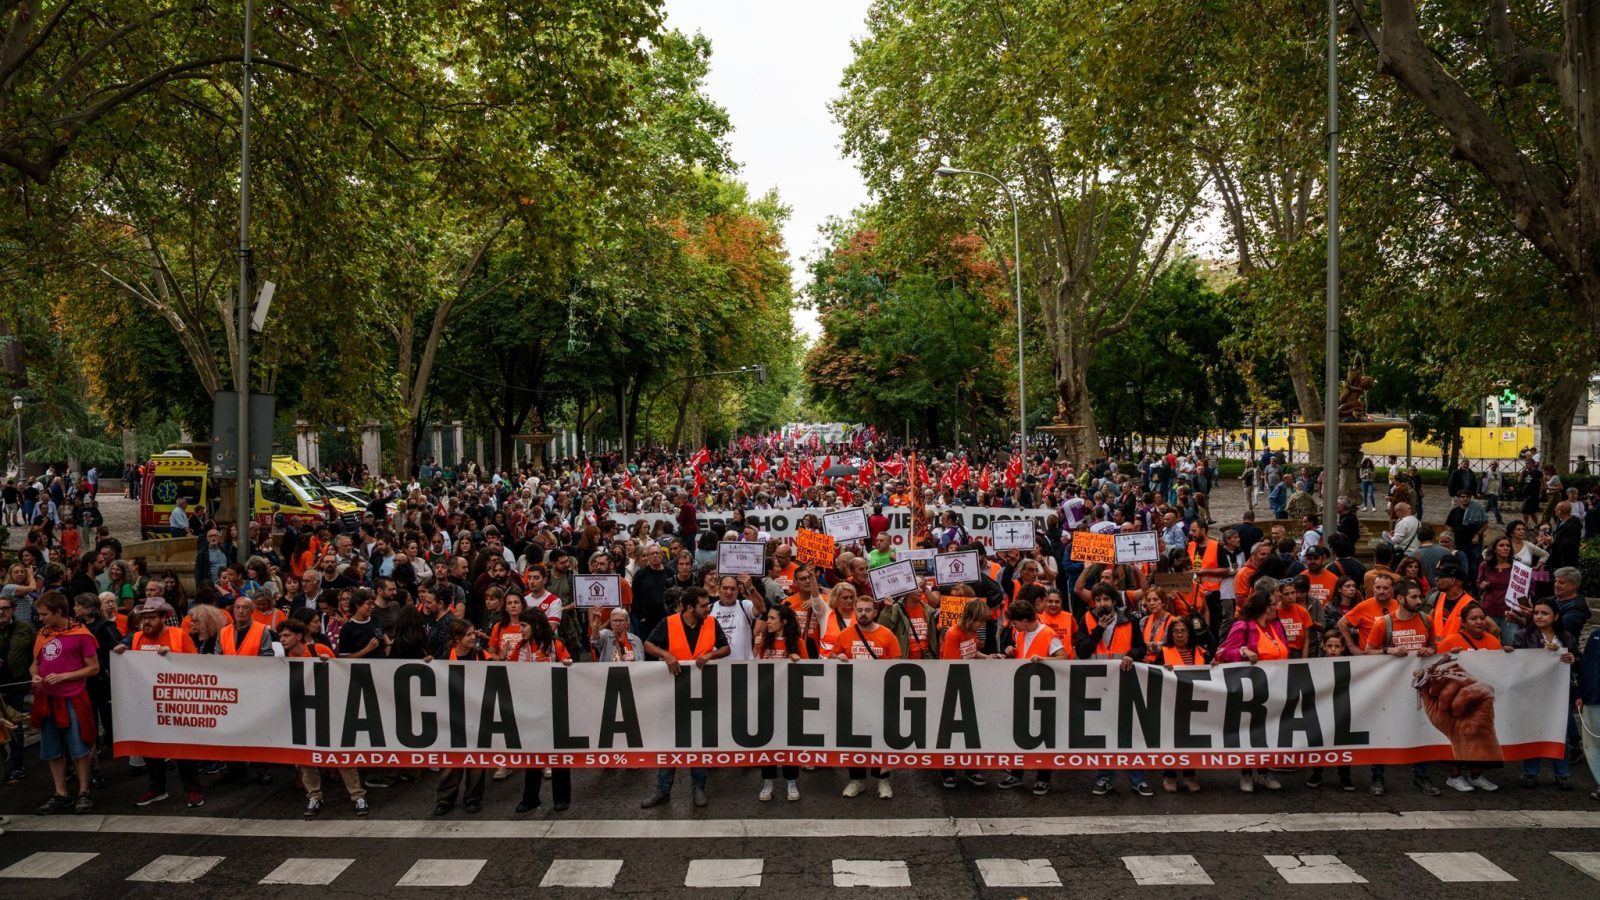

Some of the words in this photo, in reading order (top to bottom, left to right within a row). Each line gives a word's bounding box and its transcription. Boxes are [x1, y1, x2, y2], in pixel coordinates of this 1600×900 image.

[1074, 531, 1112, 543] Brookfield
[1073, 552, 1085, 560] SON
[1086, 554, 1113, 562] NUESTRAS
[941, 619, 952, 627] EN
[156, 673, 218, 686] SINDICATO
[156, 688, 170, 699] DE
[173, 688, 236, 701] INQUILINAS
[156, 703, 163, 713] E
[165, 703, 228, 716] INQUILINOS
[289, 661, 522, 749] HACIA
[551, 666, 644, 750] LA
[674, 663, 982, 750] HUELGA
[1012, 661, 1370, 750] GENERAL
[157, 715, 172, 726] DE
[173, 716, 217, 728] MADRID
[312, 752, 400, 764] BAJADA
[411, 753, 452, 765] DEL
[463, 753, 574, 766] ALQUILER
[585, 754, 628, 765] 50%
[656, 750, 828, 765] EXPROPIACIÓN
[839, 753, 932, 766] FONDOS
[944, 754, 1025, 766] BUITRE
[1053, 754, 1191, 766] CONTRATOS
[1202, 752, 1353, 765] INDEFINIDOS
